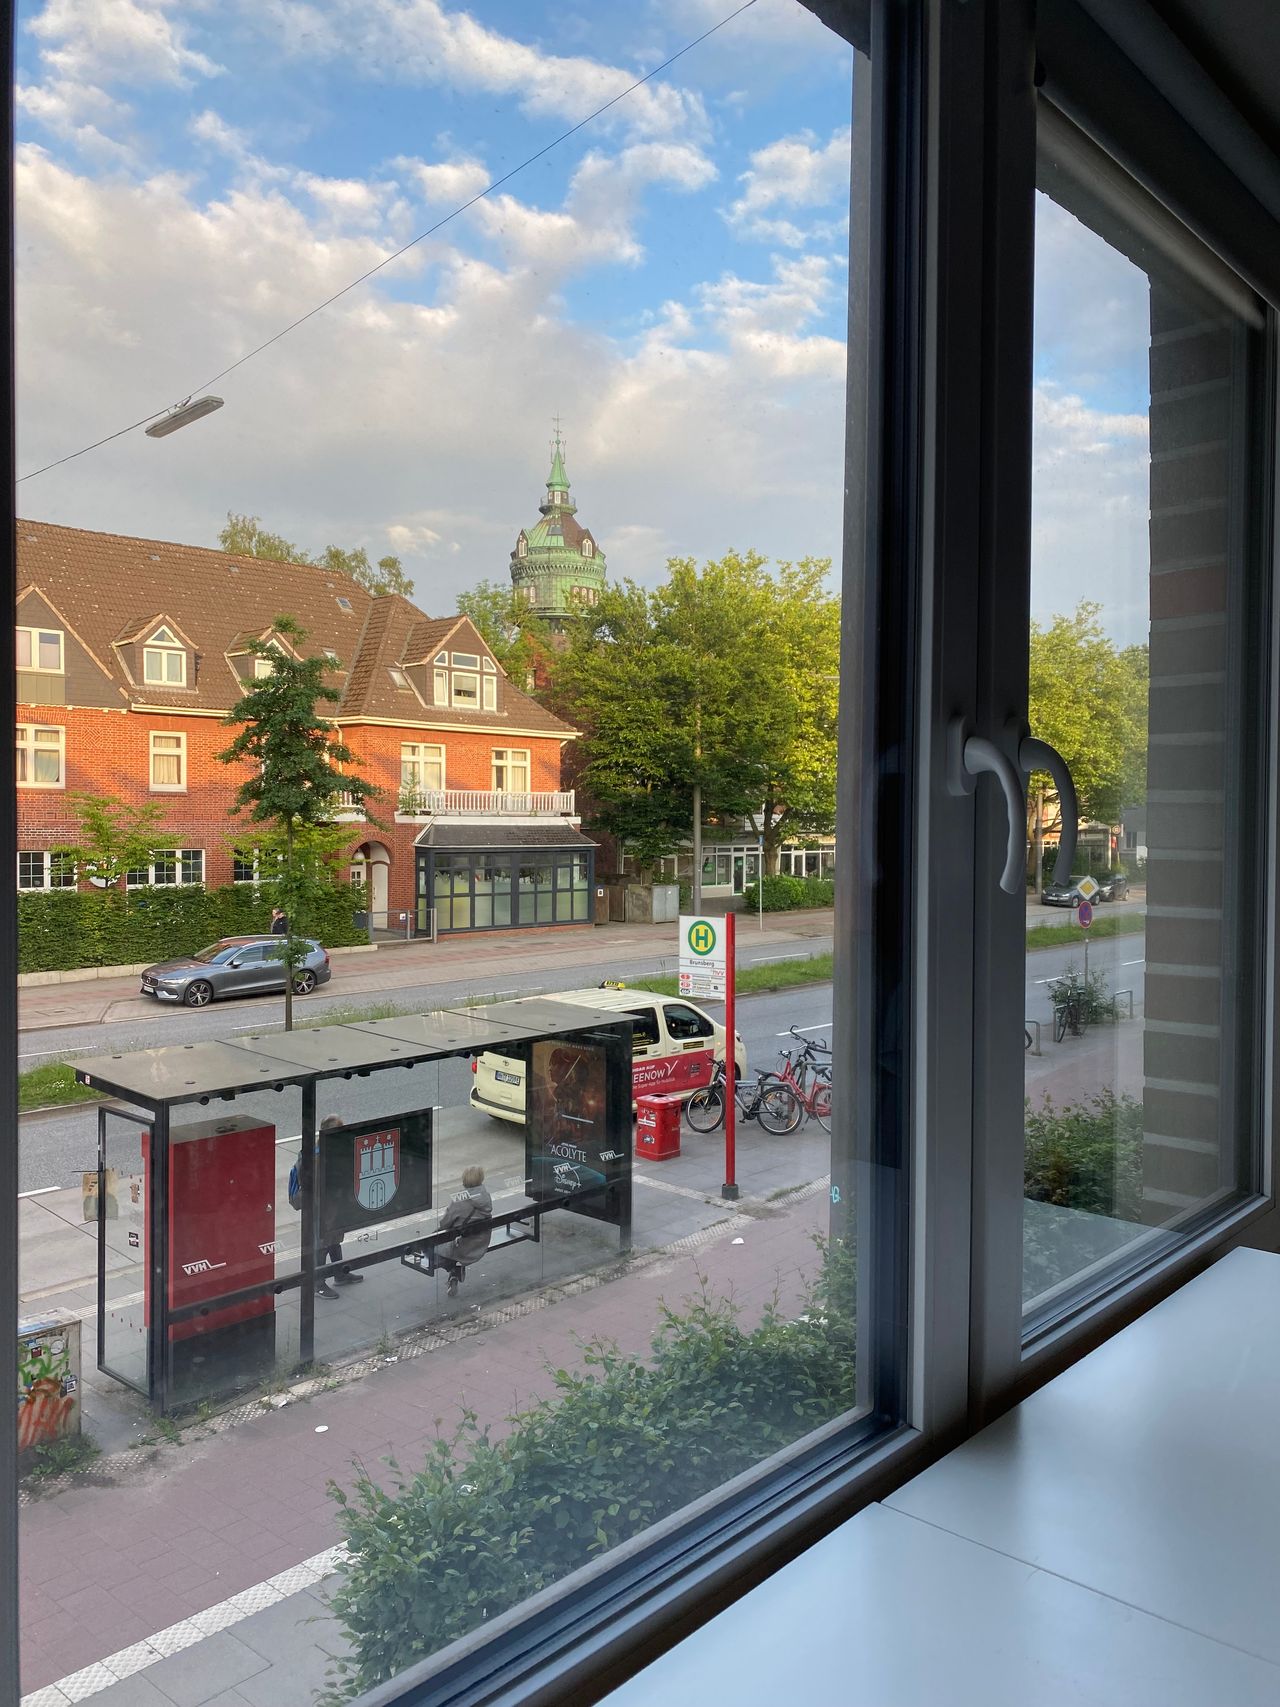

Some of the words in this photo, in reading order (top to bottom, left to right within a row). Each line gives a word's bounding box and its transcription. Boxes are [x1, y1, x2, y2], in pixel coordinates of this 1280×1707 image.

[695, 928, 709, 948] H
[633, 1068, 665, 1083] EENOW
[550, 1144, 587, 1162] ACOLYTE
